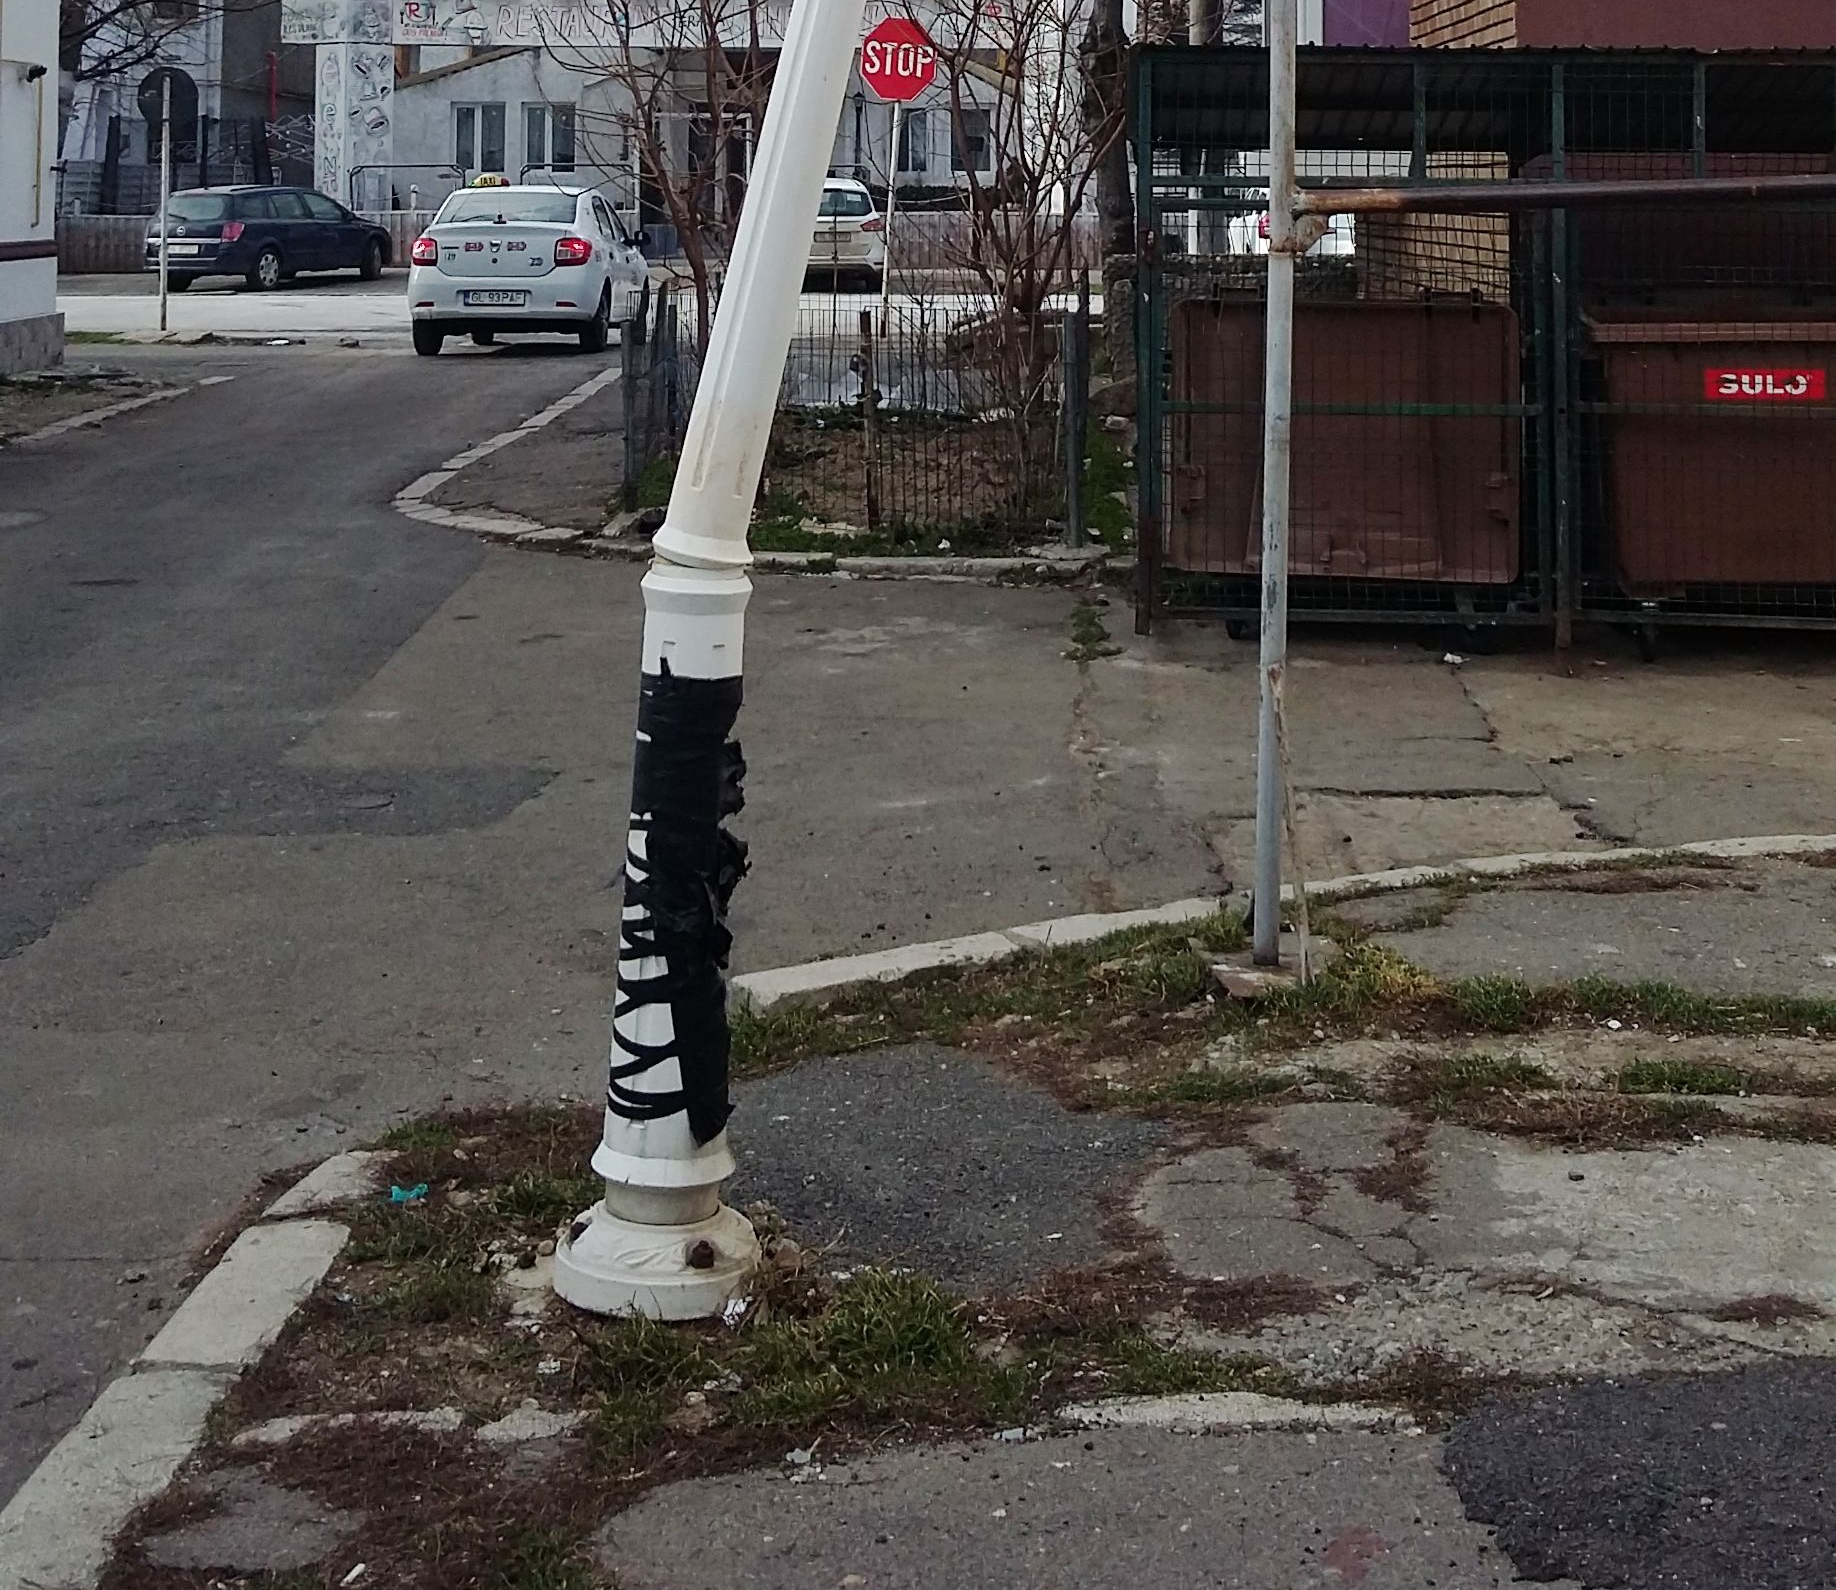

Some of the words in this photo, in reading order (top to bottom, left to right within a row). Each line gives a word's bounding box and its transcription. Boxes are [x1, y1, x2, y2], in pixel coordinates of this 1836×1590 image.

[496, 4, 670, 40] RESTAURNT
[864, 40, 934, 78] STOP
[1719, 373, 1808, 395] SULO
